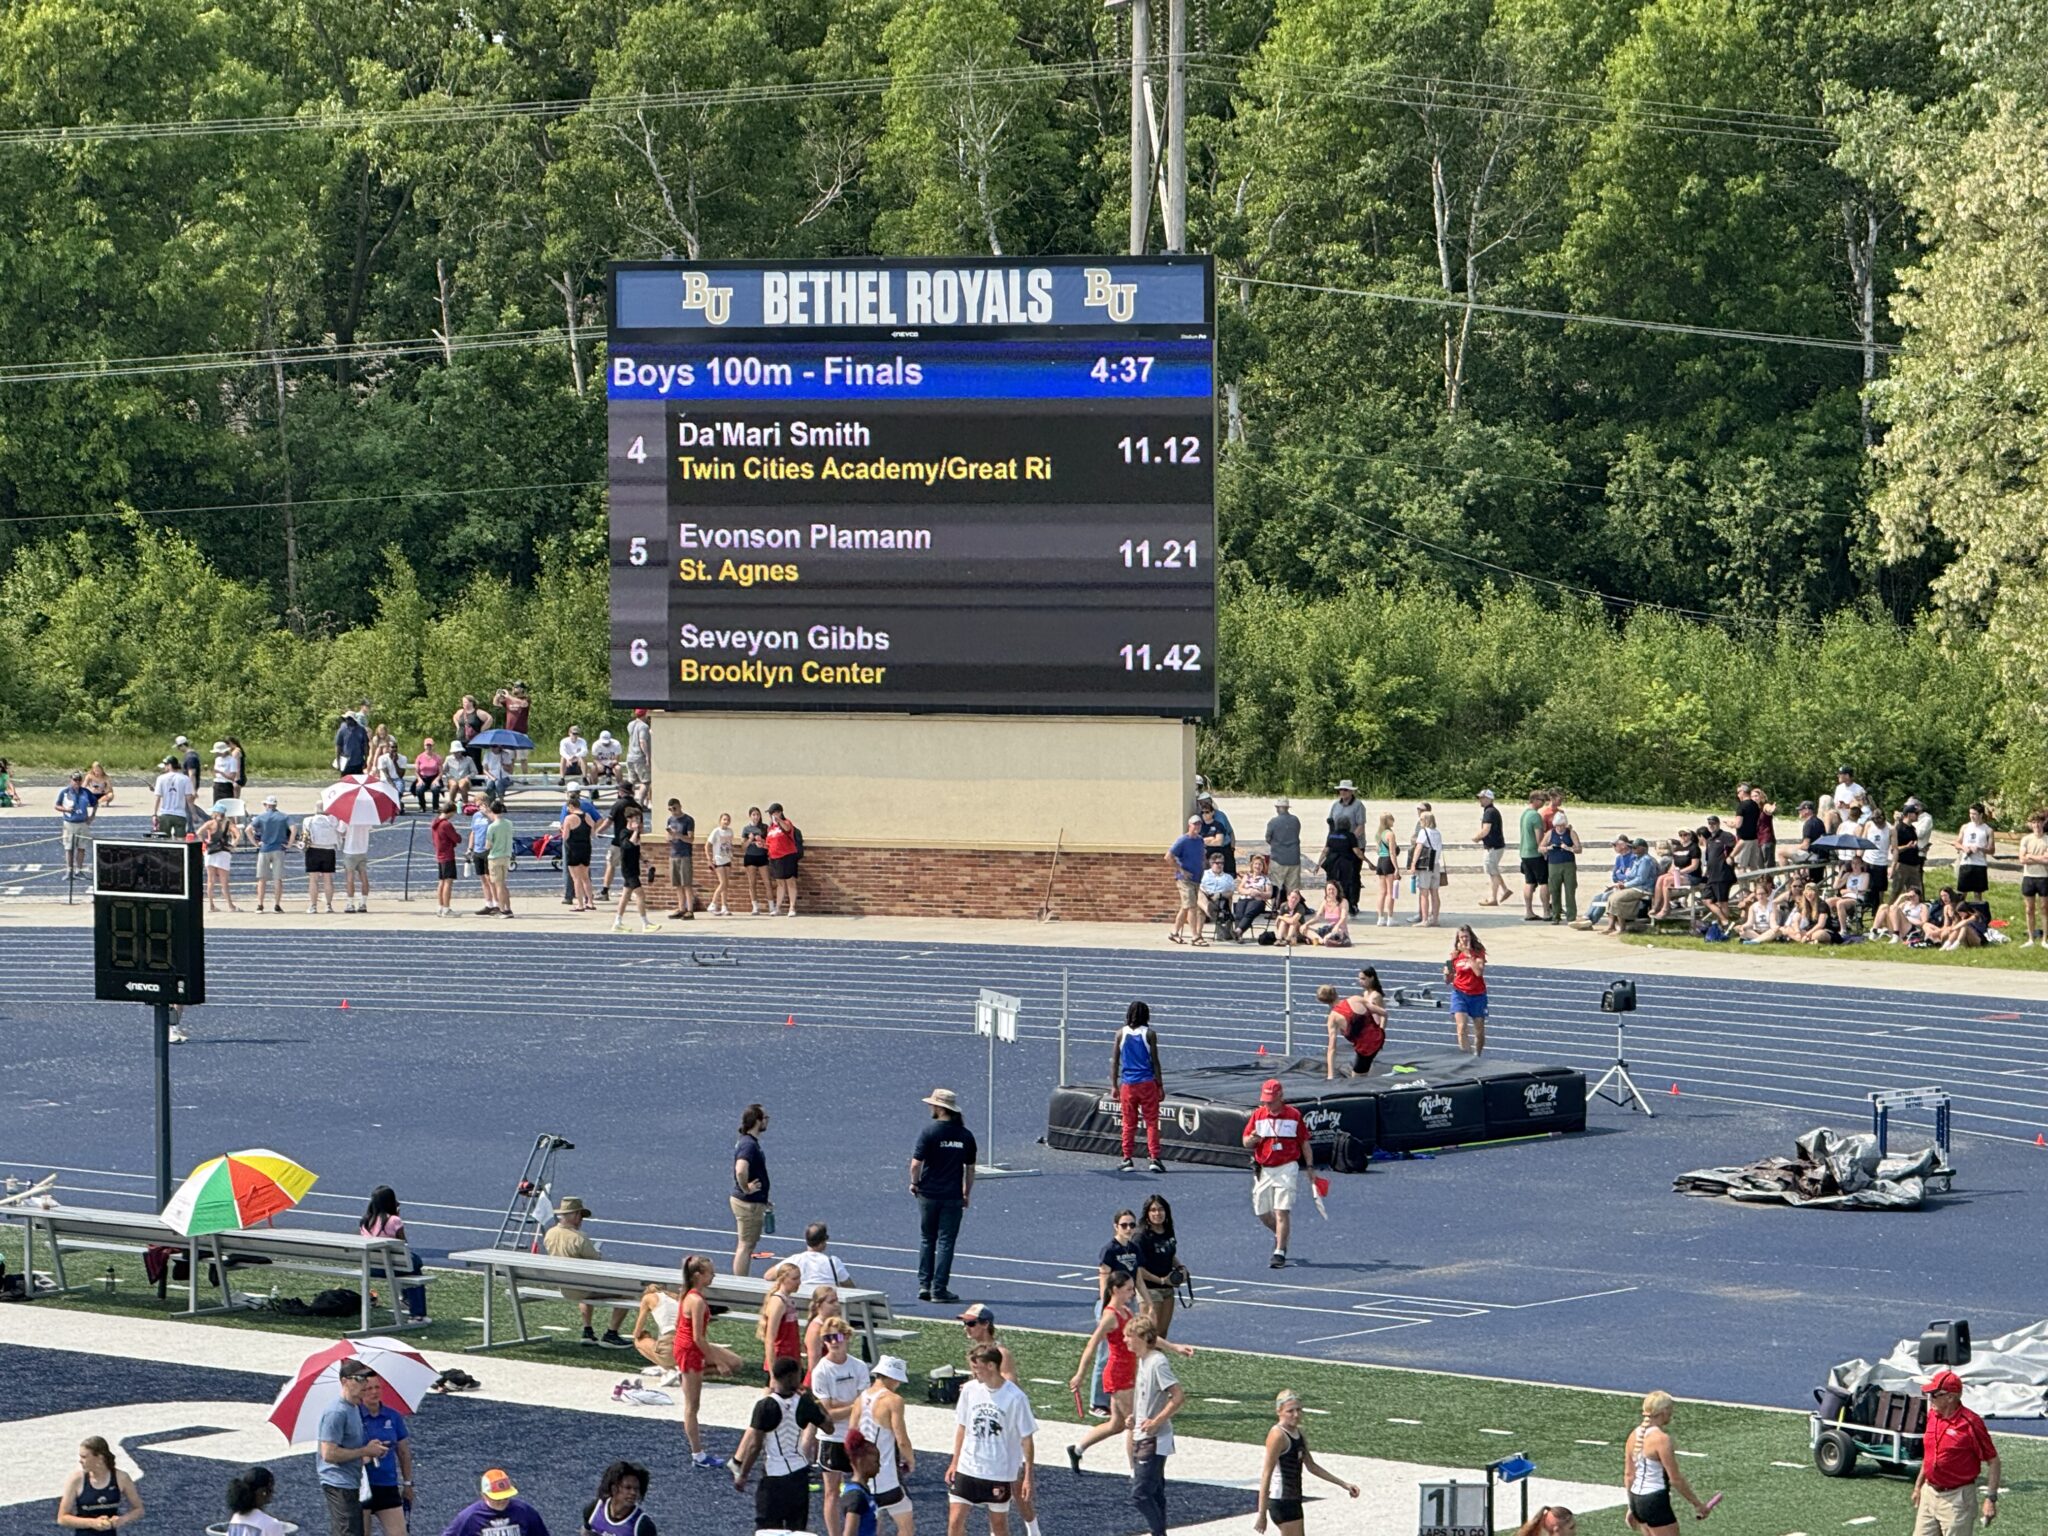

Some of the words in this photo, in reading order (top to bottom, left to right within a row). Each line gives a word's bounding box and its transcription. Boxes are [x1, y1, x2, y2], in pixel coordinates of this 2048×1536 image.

[682, 271, 735, 326] BU
[763, 270, 897, 326] BETHEL
[907, 268, 1053, 325] ROYALS
[1083, 267, 1138, 323] BU
[613, 357, 695, 394] Boys
[706, 356, 792, 387] 100m
[824, 355, 923, 387] Finals
[1090, 356, 1155, 384] 4:37
[679, 420, 781, 448] Da'Mari
[790, 420, 870, 448] Smith
[627, 436, 648, 464] 4
[1118, 435, 1201, 465] 11.12
[678, 456, 736, 481] Twin
[743, 456, 814, 481] Cities
[820, 455, 1017, 486] Academy/Great
[1025, 456, 1052, 481] Ri
[680, 523, 801, 549] Evonson
[810, 523, 931, 549] Plamann
[629, 537, 648, 567] 5
[1119, 539, 1199, 569] 11.21
[679, 560, 713, 583] St.
[718, 560, 799, 588] Agnes
[630, 638, 649, 668] 6
[680, 623, 799, 657] Seveyon
[807, 624, 890, 651] Gibbs
[1119, 642, 1201, 672] 11.42
[681, 659, 793, 689] Brooklyn
[801, 659, 886, 685] Center
[1418, 1094, 1453, 1116] Richey
[1524, 1082, 1559, 1105] Richey
[1303, 1109, 1341, 1130] Richey
[1428, 1488, 1445, 1527] 1
[1450, 1528, 1466, 1536] TO
